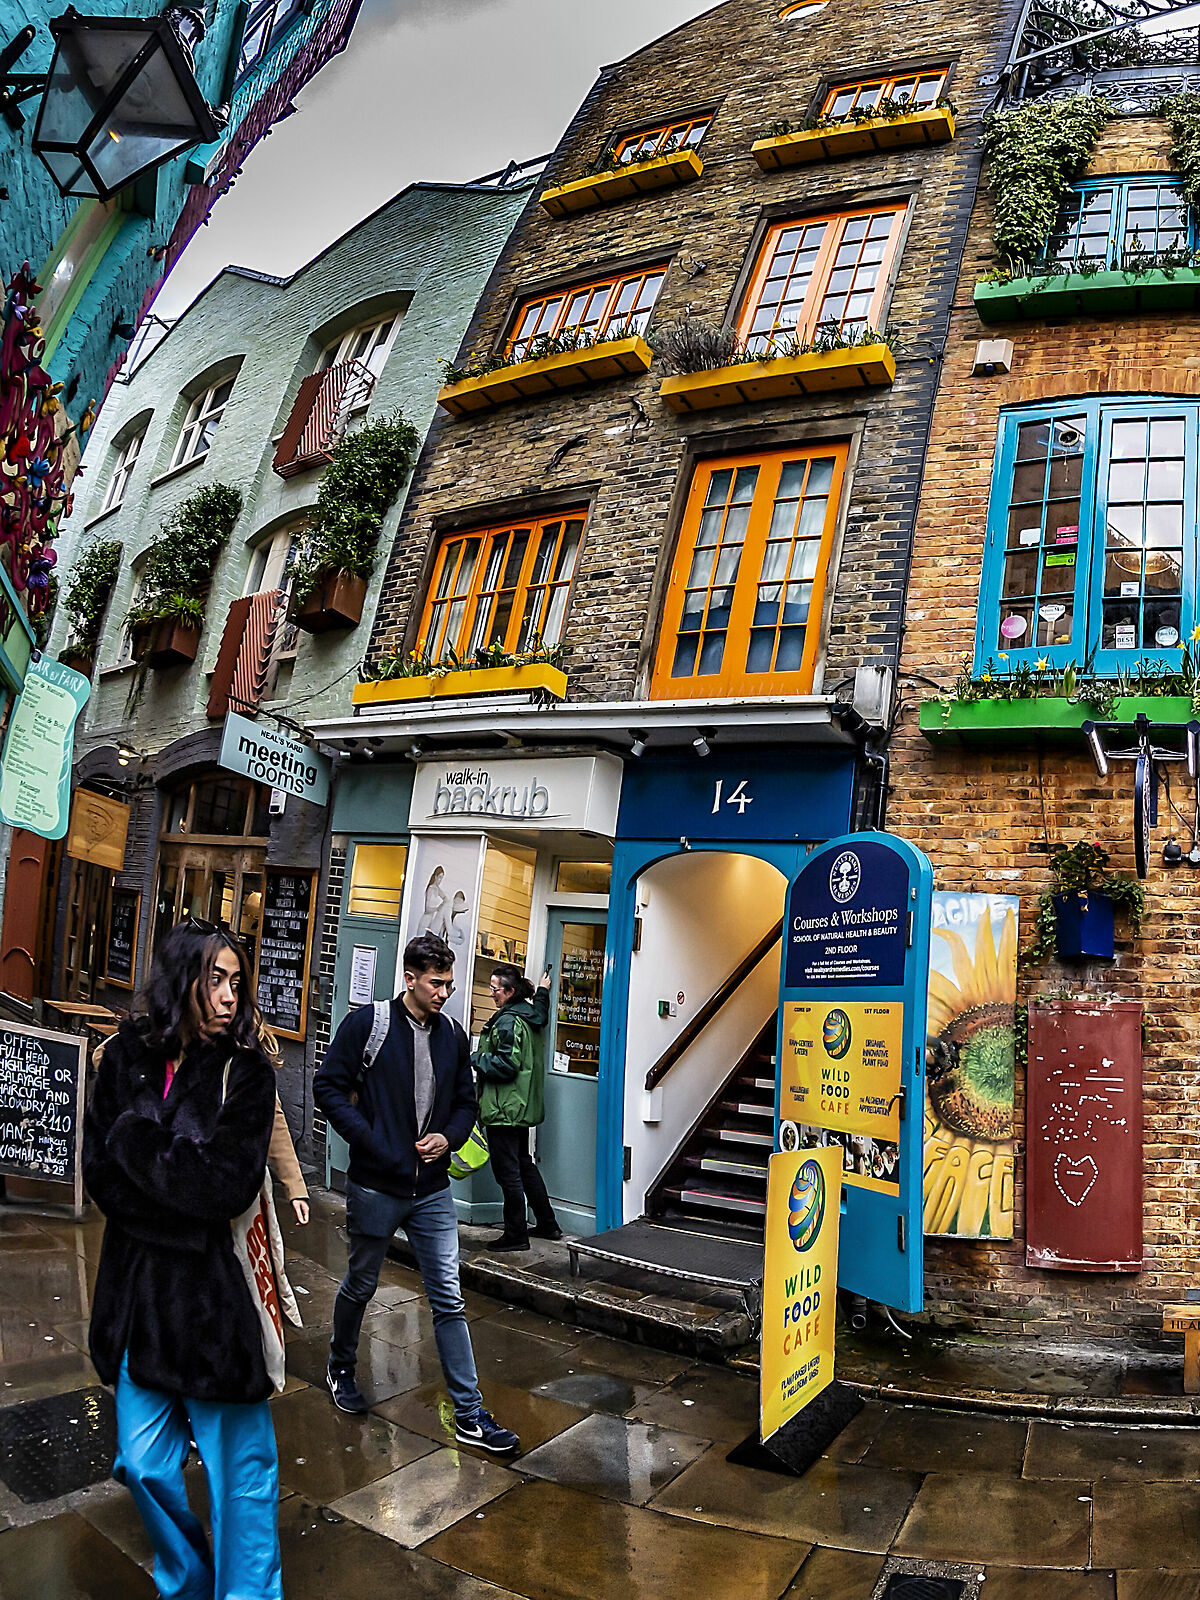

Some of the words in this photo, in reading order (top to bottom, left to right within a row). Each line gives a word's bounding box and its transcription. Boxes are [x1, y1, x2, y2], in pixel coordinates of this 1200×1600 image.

[261, 729, 285, 746] NEAL'S
[286, 740, 304, 754] YARD
[238, 735, 317, 786] meeting
[247, 758, 304, 793] rooms
[446, 768, 489, 786] walk-in
[433, 777, 549, 816] backrub
[712, 780, 754, 814] 14
[793, 916, 829, 931] Courses
[830, 911, 840, 927] &
[841, 907, 898, 925] Workshops
[793, 934, 812, 943] SCHOOL
[812, 933, 820, 941] OF
[820, 931, 844, 941] NATURAL
[845, 929, 867, 938] HEALTH
[873, 926, 898, 936] BEAUTY
[825, 946, 836, 955] 2ND
[837, 945, 858, 954] FLOOR
[4, 1032, 44, 1053] OFFER
[566, 1040, 584, 1050] Come
[0, 1044, 24, 1060] FULL
[26, 1051, 50, 1066] HEAD
[862, 1058, 876, 1067] PLANT
[0, 1059, 49, 1077] HIGHLIGHT
[55, 1069, 73, 1084] OR
[821, 1067, 850, 1083] WILD
[46, 1090, 70, 1105] AND
[821, 1084, 850, 1099] FOOD
[820, 1100, 849, 1115] CAFE
[785, 1264, 821, 1298] WILD
[784, 1291, 820, 1328] FOOD
[783, 1313, 820, 1355] CAFE
